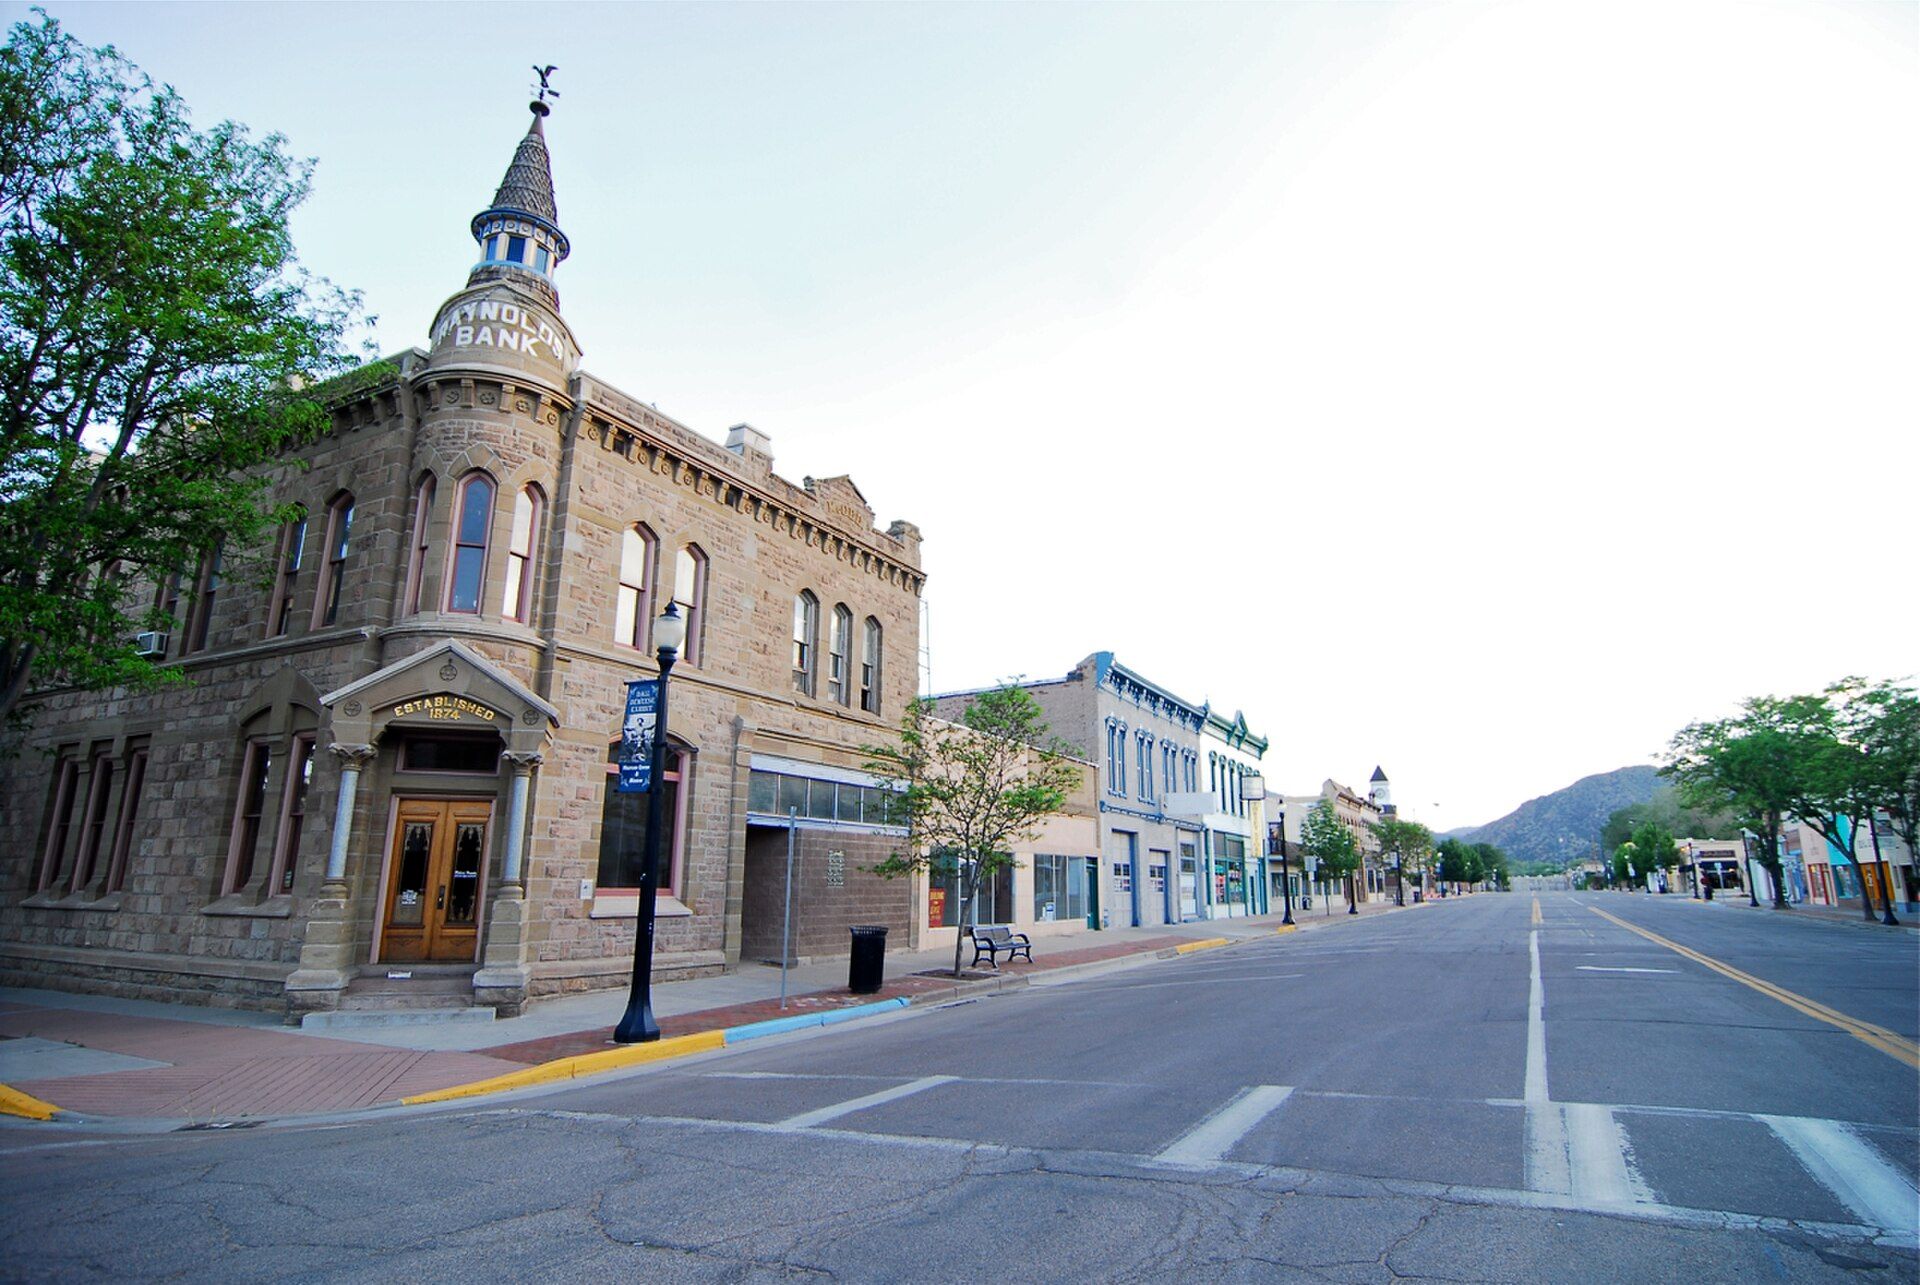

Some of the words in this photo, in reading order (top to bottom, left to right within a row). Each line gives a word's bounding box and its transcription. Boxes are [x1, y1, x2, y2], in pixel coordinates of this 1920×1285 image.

[455, 325, 538, 358] BANK
[394, 696, 495, 720] ESTABLISHED
[429, 708, 460, 720] 1874
